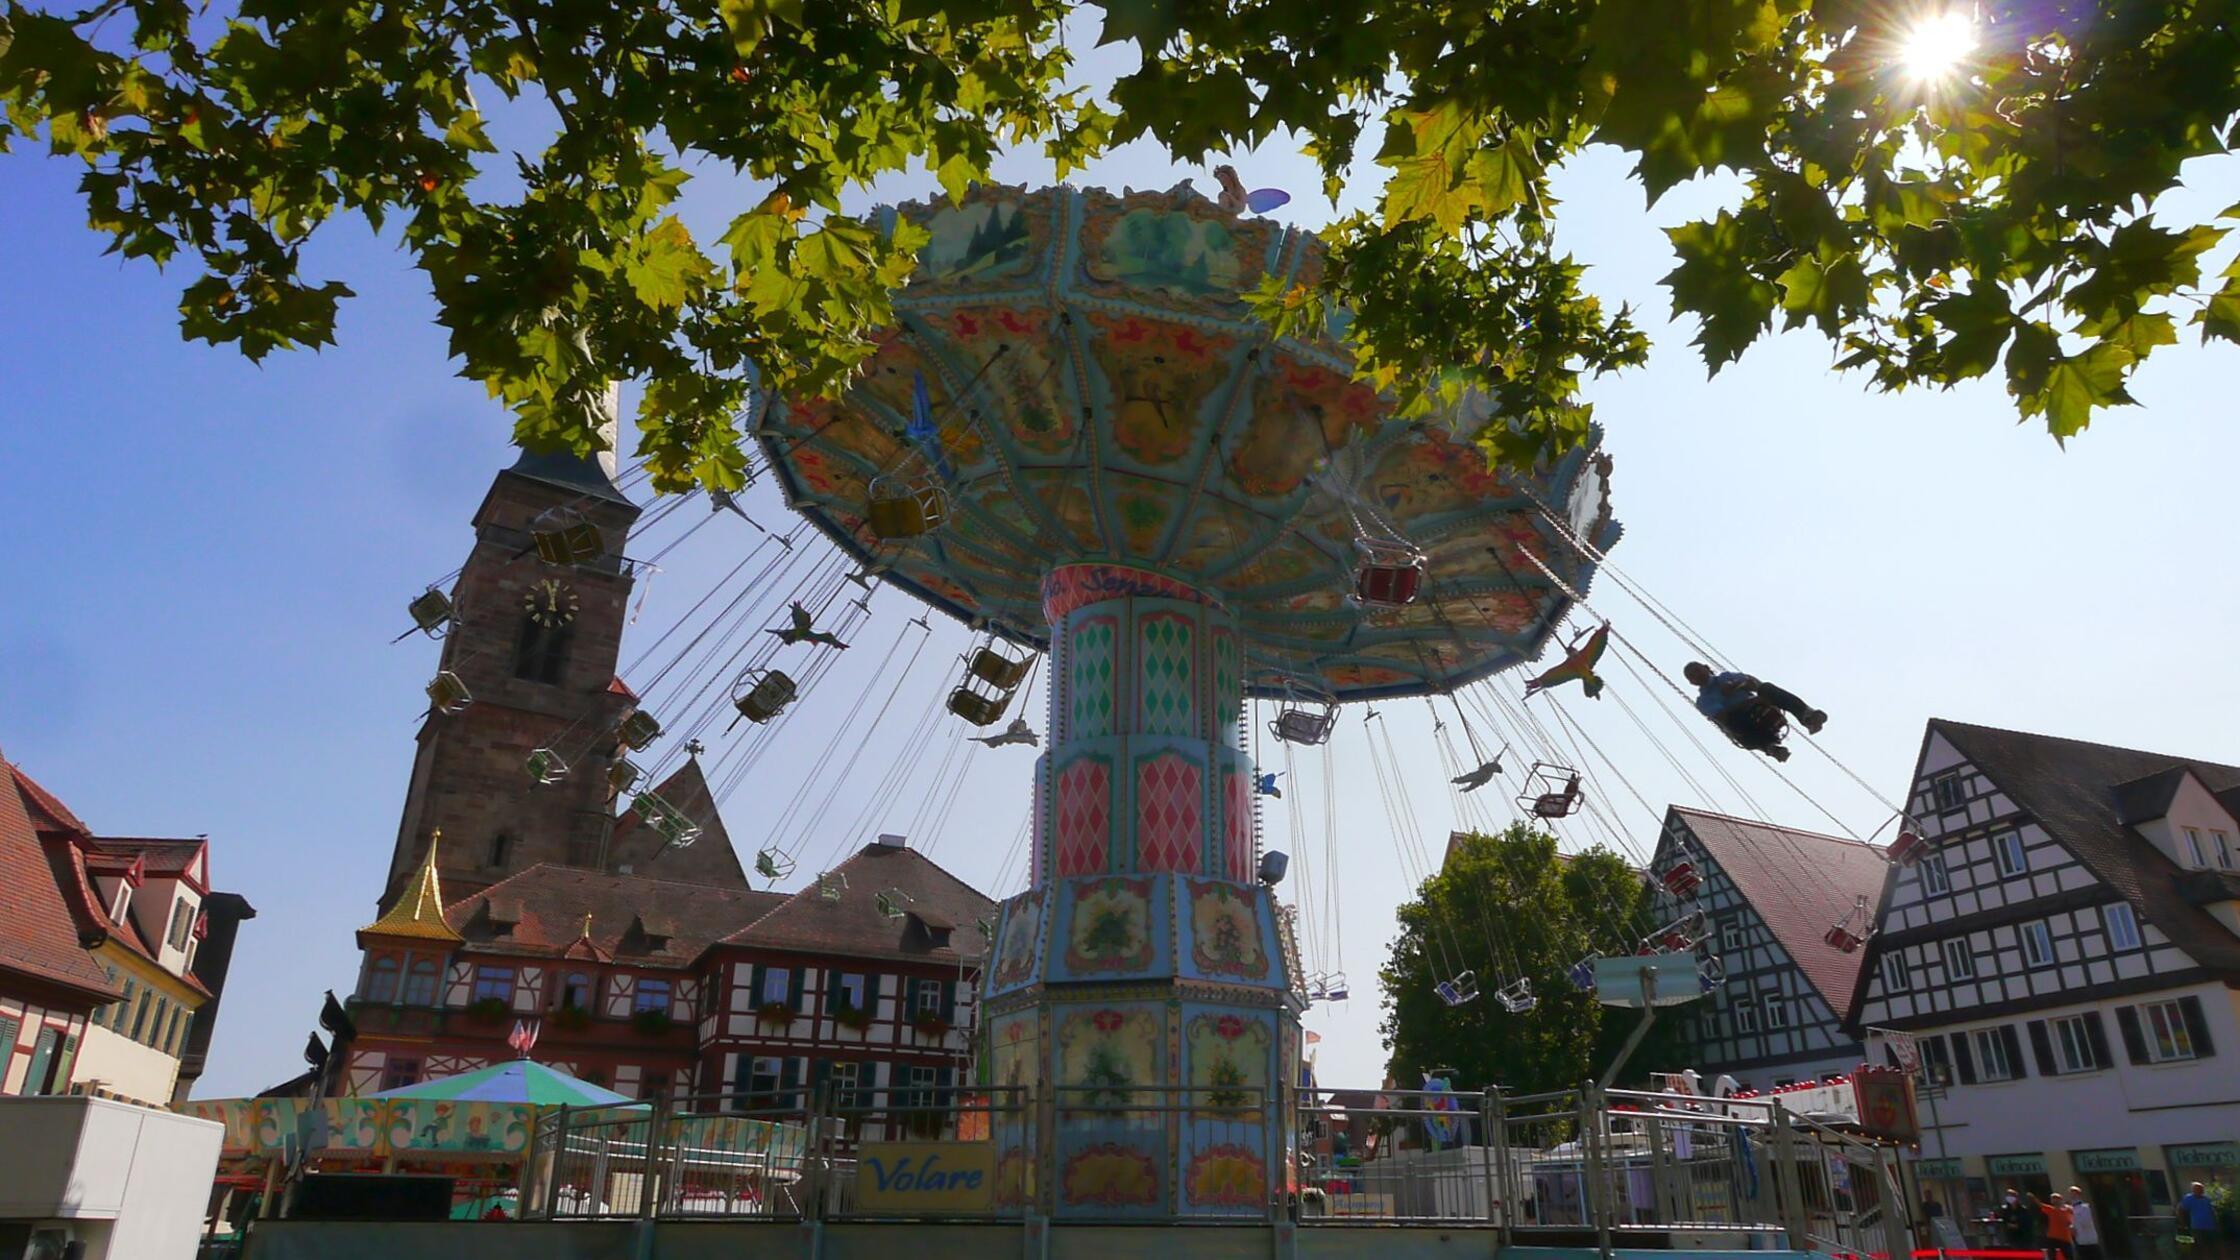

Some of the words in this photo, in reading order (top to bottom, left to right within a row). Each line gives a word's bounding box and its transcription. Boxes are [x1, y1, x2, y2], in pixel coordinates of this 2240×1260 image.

[1995, 1159, 2043, 1172] Fielmann
[2082, 1155, 2135, 1169] Fielmann
[864, 1153, 983, 1191] Volare
